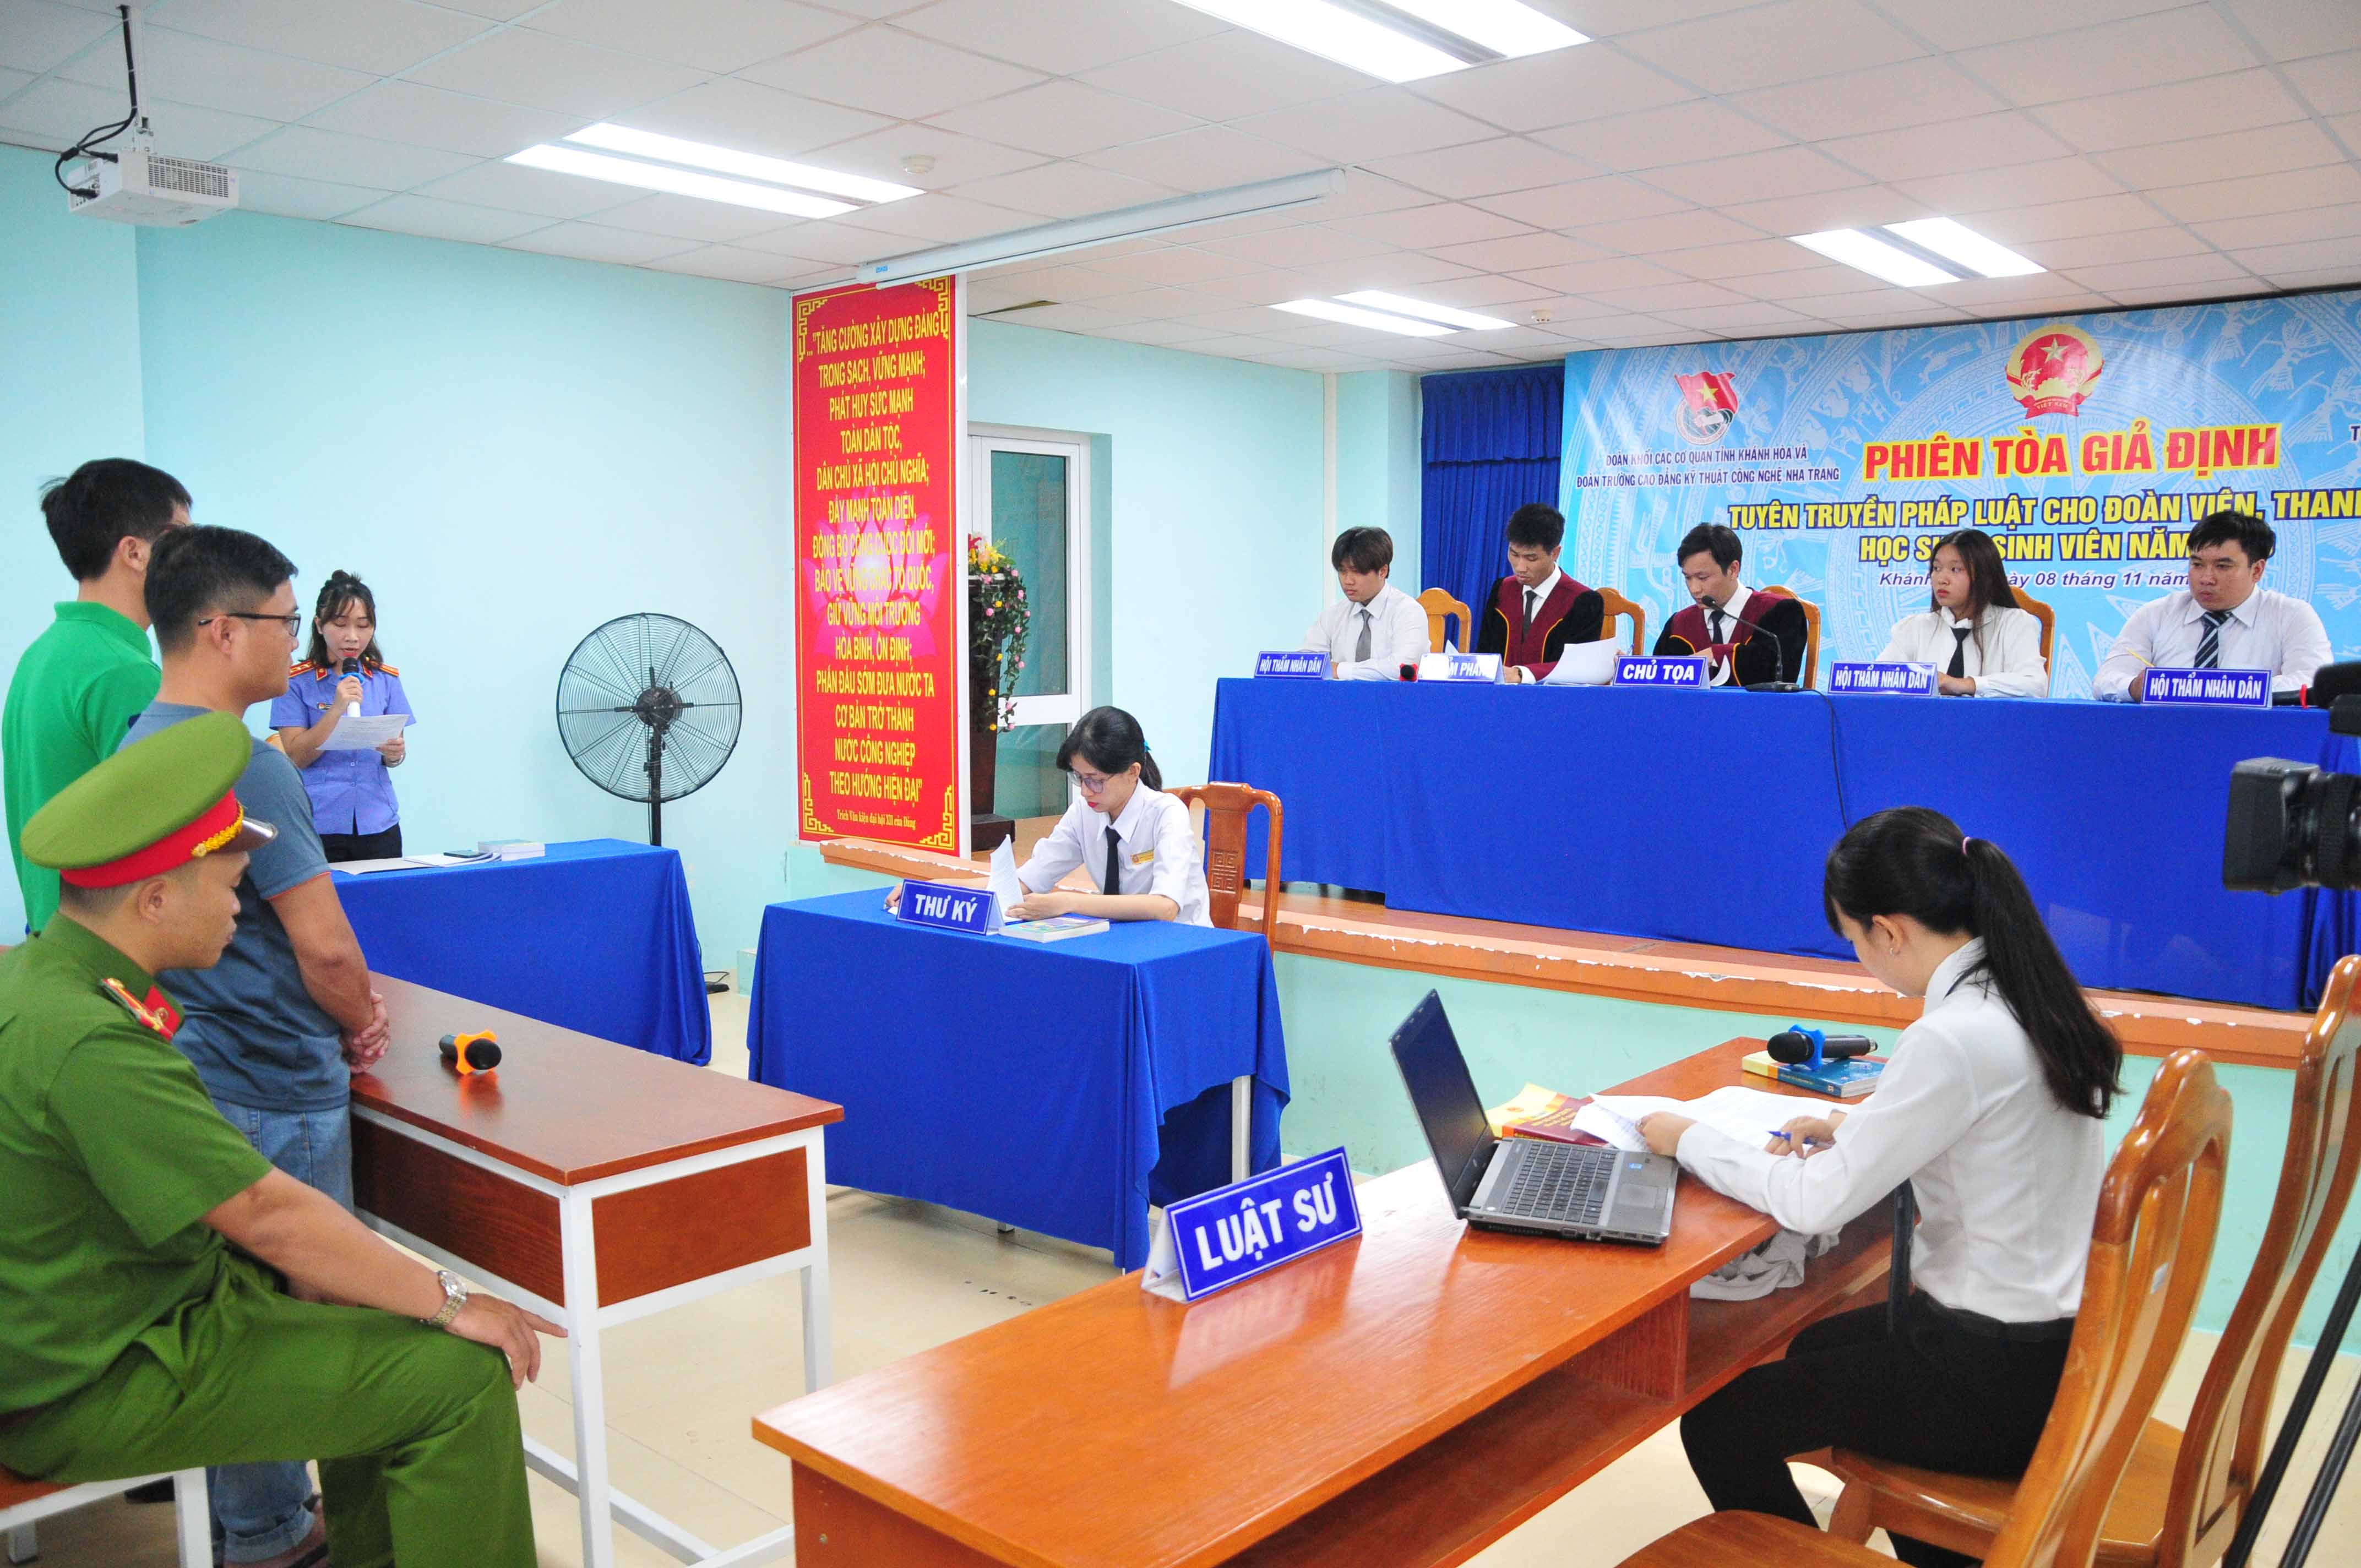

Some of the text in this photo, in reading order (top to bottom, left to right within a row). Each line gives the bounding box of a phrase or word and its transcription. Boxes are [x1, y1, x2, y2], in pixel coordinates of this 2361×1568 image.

[839, 319, 868, 351] CƯỜNG
[870, 315, 887, 346] XÂY
[888, 316, 913, 348] DỰNG
[915, 307, 939, 339] ĐẢNG
[819, 361, 845, 388] TRONG
[847, 358, 871, 389] SẠCH,
[872, 350, 896, 380] VỮNG
[829, 385, 913, 421] PHÁT HUY SỨC MẠNH
[840, 421, 902, 455] TOÀN DÂN TỘC,
[1606, 444, 1807, 466] ĐOÀN KHỐI CÁC CƠ QUAN TỈNH KHÁNH HÒA VÀ
[1864, 420, 2278, 480] PHIÊN TÒA GIẢ ĐỊNH
[817, 460, 833, 491] DÂN
[834, 459, 851, 489] CHỦ
[852, 458, 863, 487] XÃ
[865, 459, 879, 492] HỘI
[881, 454, 898, 485] CHỦ
[1577, 473, 1599, 488] ĐOÀN
[1602, 472, 1635, 487] TRƯỜNG
[1638, 475, 1655, 486] CAO
[1684, 470, 1696, 484] KỸ
[1699, 469, 1728, 487] THUẬT
[1731, 468, 1755, 483] CÔNG
[1758, 467, 1782, 484] NGHỆ
[1786, 469, 1804, 481] NHA
[1808, 468, 1839, 481] TRANG
[846, 497, 869, 527] MẠNH
[871, 490, 893, 520] TOÀN
[1729, 500, 1798, 529] TUYÊN
[1805, 496, 1895, 527] TRUYỀN
[1901, 496, 1967, 527] PHÁP
[1974, 494, 2036, 530] LUẬT
[2042, 497, 2097, 525] CHO
[2103, 489, 2181, 523] ĐOÀN
[2272, 489, 2361, 520] THAN
[813, 529, 835, 558] ĐỒNG
[836, 530, 848, 563] BỘ
[851, 527, 873, 558] CÔNG
[1860, 536, 1909, 566] HỌC
[1992, 534, 2053, 561] SINH
[2059, 528, 2121, 560] VIÊN
[2128, 526, 2190, 559] NĂM
[814, 563, 831, 592] BẢO
[833, 565, 844, 596] VỆ
[2034, 573, 2056, 585] 08
[2062, 573, 2116, 587] tháng
[2123, 573, 2142, 585] 11
[2148, 574, 2189, 585] năm
[828, 595, 920, 625] GIỮ VỮNG MÔI TRƯỜNG
[835, 630, 852, 660] HÒA
[853, 630, 874, 665] BÌNH,
[1259, 654, 1322, 674] HỘI THẨM NHÂN DÂN
[817, 665, 934, 697] PHẤN ĐẤU SỚM ĐƯA NƯỚC TA
[1623, 659, 1694, 684] CHỦ TỌA
[1835, 666, 1852, 689] HỘI
[1853, 665, 1879, 687] THẨM
[1880, 667, 1907, 688] NHÂN
[2150, 672, 2262, 700] HỘI THẨM NHÂN DÂN
[835, 699, 914, 731] CƠ BẢN TRỞ THÀNH
[835, 732, 915, 772] NƯỚC CÔNG NGHIỆP
[829, 771, 850, 796] THEO
[852, 767, 882, 798] HƯỚNG
[884, 772, 902, 805] HIỆN
[915, 894, 978, 923] THƯ KÝ
[1195, 1172, 1337, 1271] LUẬT SƯ
